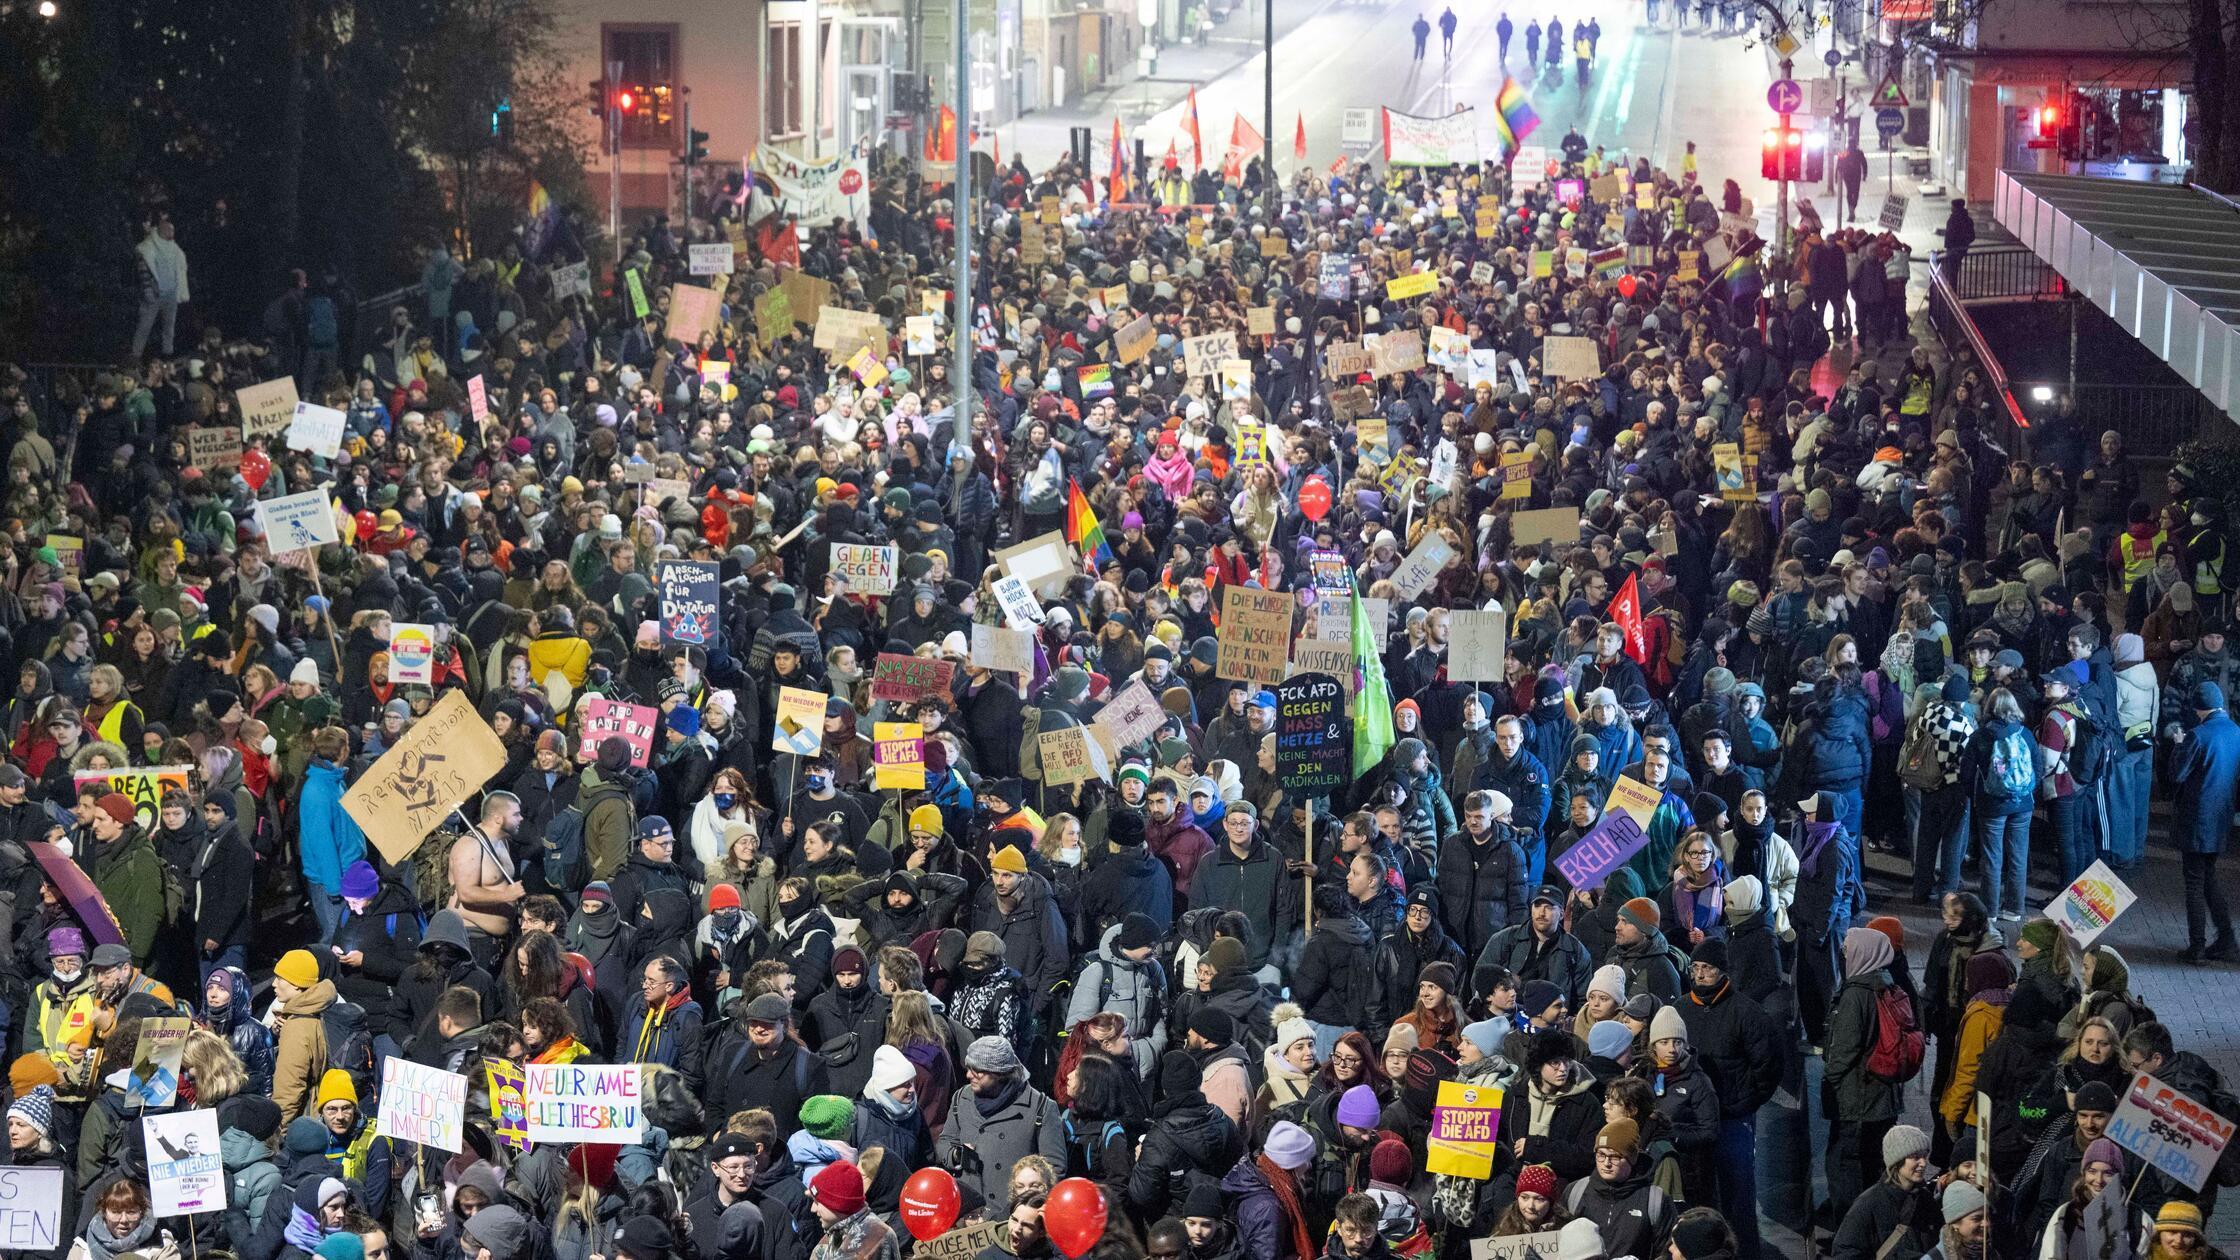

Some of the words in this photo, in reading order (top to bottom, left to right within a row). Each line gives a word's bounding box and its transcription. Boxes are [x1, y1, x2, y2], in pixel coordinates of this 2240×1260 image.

[1194, 338, 1230, 356] FCK
[193, 434, 216, 444] WER
[838, 563, 890, 577] GEGEN
[1232, 593, 1250, 606] DIE
[1226, 626, 1287, 647] MENSCHEN
[1222, 644, 1239, 658] IST
[1244, 647, 1269, 662] KEIN
[879, 660, 936, 678] NAZIS
[1278, 684, 1306, 701] FCK
[1310, 684, 1337, 697] AFD
[793, 697, 814, 706] WIEDER
[1282, 702, 1332, 716] GEGEN
[608, 706, 632, 720] AFD
[1124, 704, 1144, 725] KEINE
[1284, 716, 1323, 734] HASS
[1040, 734, 1062, 744] EENE
[1279, 732, 1324, 747] HETZE
[1327, 723, 1340, 738] &
[880, 740, 916, 752] STOPPT
[358, 704, 469, 816] Remigration
[881, 752, 898, 764] DIE
[900, 750, 919, 762] AFD
[1044, 752, 1056, 761] DIE
[1062, 750, 1082, 760] AFD
[1065, 758, 1082, 768] WEG
[1278, 751, 1307, 762] KEINE
[1310, 748, 1345, 760] MACHT
[1298, 762, 1322, 775] DEN
[1282, 775, 1341, 788] RADIKALEN
[408, 769, 467, 834] NAZIS
[1617, 784, 1627, 794] NIE
[1626, 788, 1648, 802] WIEDER
[2082, 881, 2116, 911] STOPPT
[2068, 890, 2106, 928] BRANDSTIFTER
[154, 1030, 174, 1038] WIEDER
[507, 1103, 522, 1117] AFD
[1442, 1110, 1491, 1126] STOPPT
[2130, 1076, 2232, 1152] LESBEN
[1440, 1124, 1464, 1138] DIE
[1464, 1126, 1490, 1140] AFD
[2109, 1118, 2152, 1156] ALICE
[2148, 1118, 2192, 1150] gegen
[152, 1163, 172, 1180] NIE
[174, 1154, 220, 1176] WIEDER!
[918, 1236, 967, 1256] EXCUSE
[1486, 1240, 1514, 1260] Say
